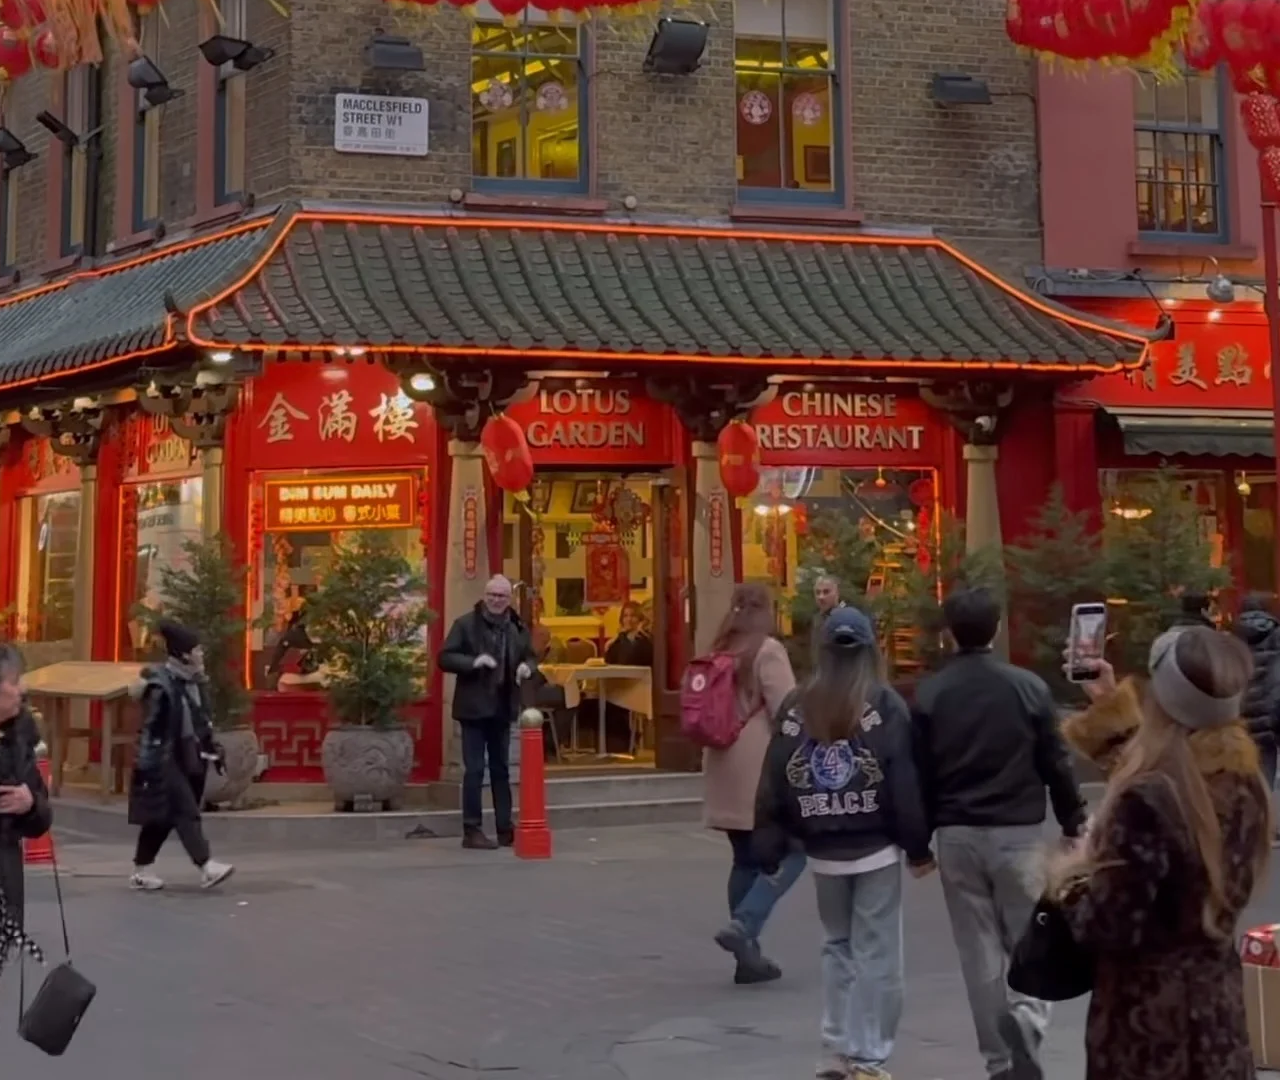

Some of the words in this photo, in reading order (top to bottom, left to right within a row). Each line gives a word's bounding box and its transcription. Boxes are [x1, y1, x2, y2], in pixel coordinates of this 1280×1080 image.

[342, 98, 423, 114] MACCLESFIELD
[342, 111, 383, 125] STREET
[386, 114, 403, 126] W1
[257, 388, 420, 445] 金滿樓
[540, 389, 630, 416] LOTUS
[782, 391, 898, 419] CHINESE
[527, 420, 645, 449] GARDEN
[756, 423, 924, 451] RESTAURANT
[279, 486, 309, 502] DIM
[312, 484, 347, 501] SUM
[351, 482, 397, 499] DAILY
[823, 745, 842, 774] 4
[798, 789, 880, 818] PEACE
